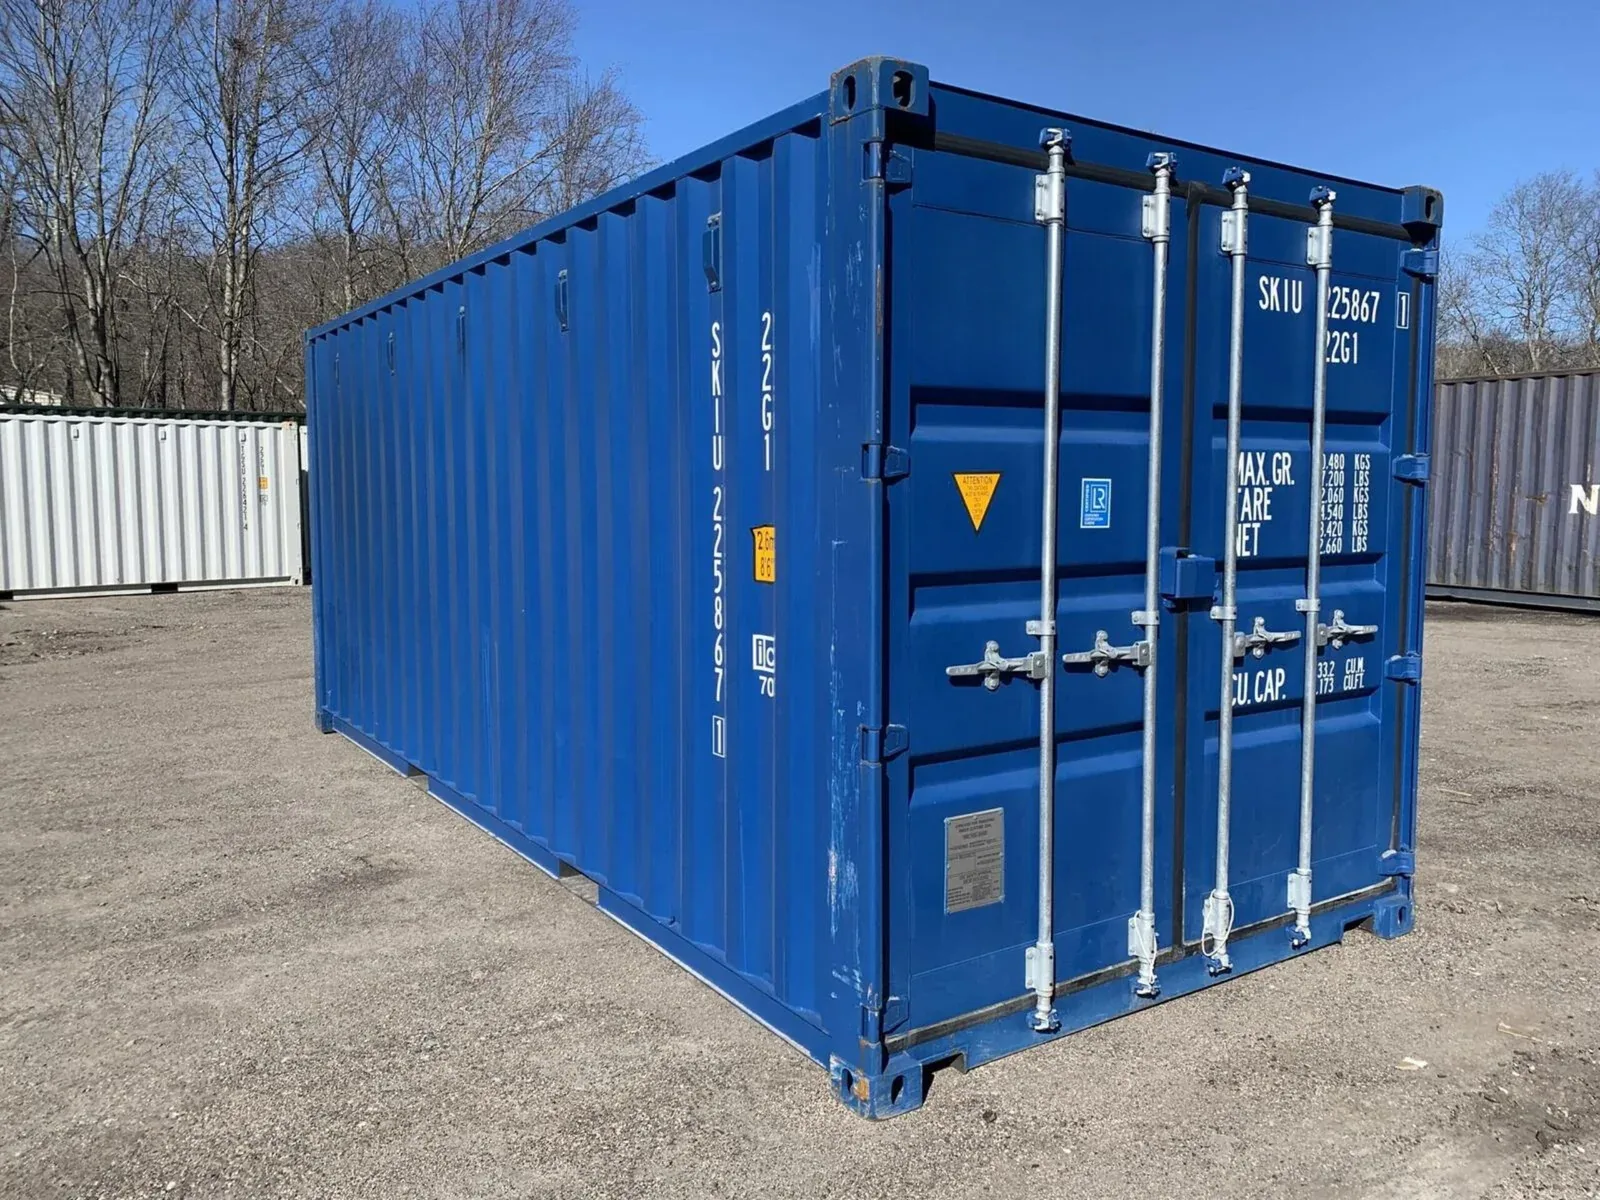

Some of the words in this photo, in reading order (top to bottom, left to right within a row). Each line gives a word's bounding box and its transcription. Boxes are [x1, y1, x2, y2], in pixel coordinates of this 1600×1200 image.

[1258, 275, 1302, 314] SKIU
[711, 321, 722, 470] SKIU
[761, 312, 772, 471] 22G1
[1272, 451, 1295, 485] GR.
[1354, 453, 1371, 470] KGS
[1354, 470, 1370, 487] LBS
[1238, 487, 1273, 522] ARE
[1353, 487, 1370, 503] KGS
[1568, 484, 1600, 515] N
[1353, 503, 1369, 520] LBS
[1352, 520, 1369, 536] KGS
[1351, 536, 1367, 553] LBS
[713, 486, 723, 702] 225867
[759, 675, 775, 698] 70
[1254, 667, 1287, 703] CAP.
[714, 718, 724, 756] 1
